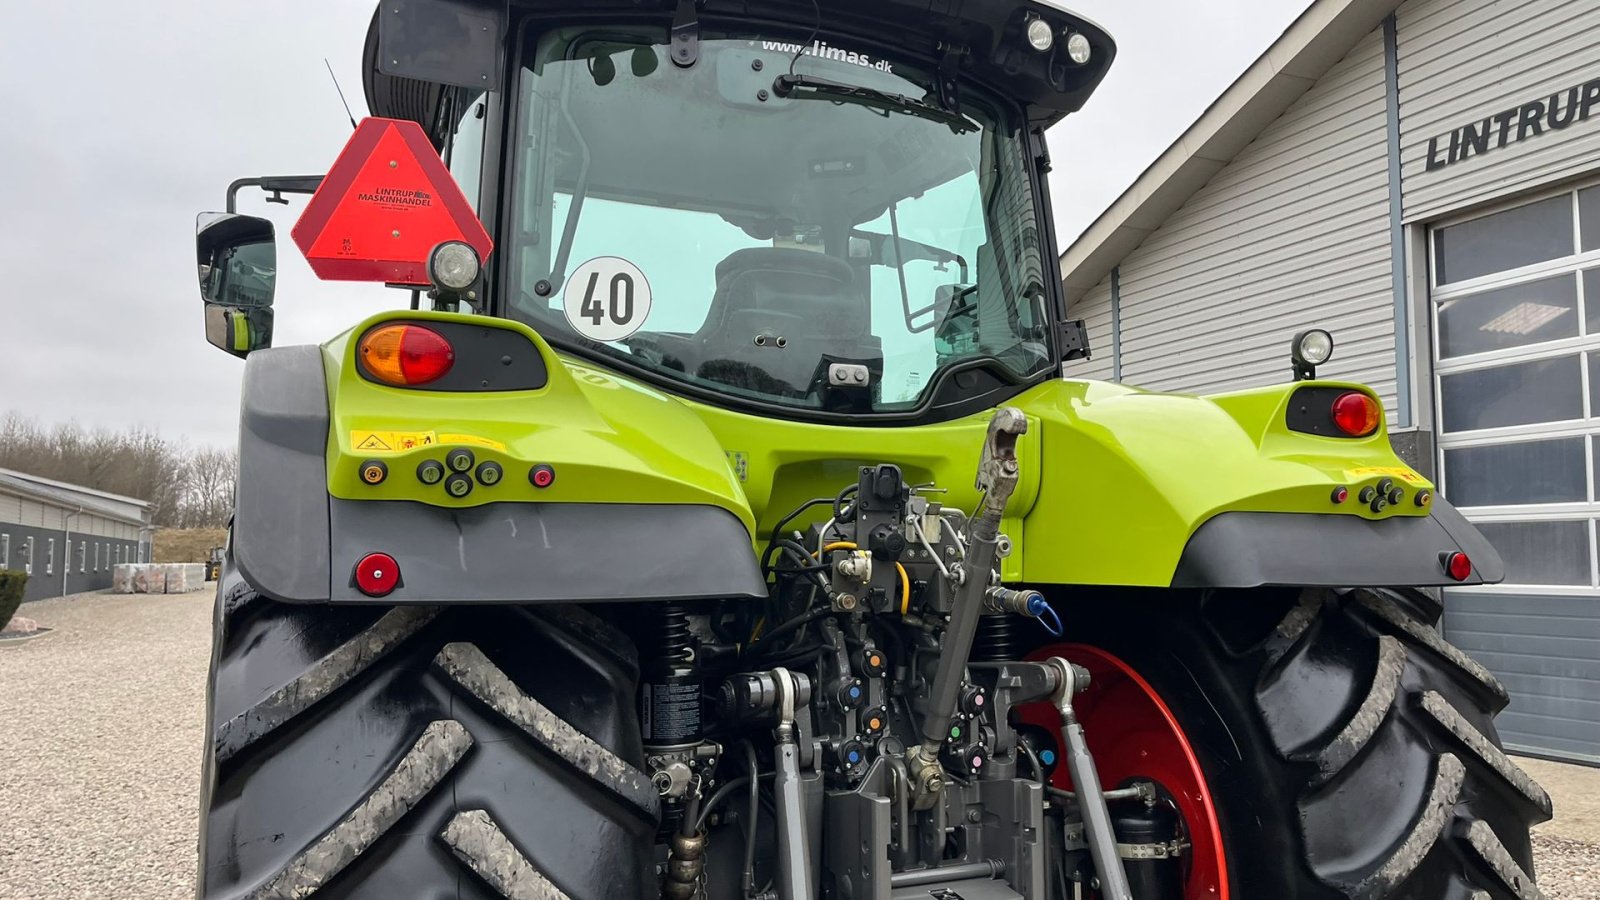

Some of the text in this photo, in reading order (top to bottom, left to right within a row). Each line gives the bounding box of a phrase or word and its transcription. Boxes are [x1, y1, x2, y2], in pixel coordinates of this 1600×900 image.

[761, 39, 893, 74] www.limas.dk
[1425, 76, 1600, 172] LINTRUP
[358, 193, 432, 207] MASKINHANDEL
[375, 187, 416, 198] LINTRUP
[580, 272, 634, 326] 40
